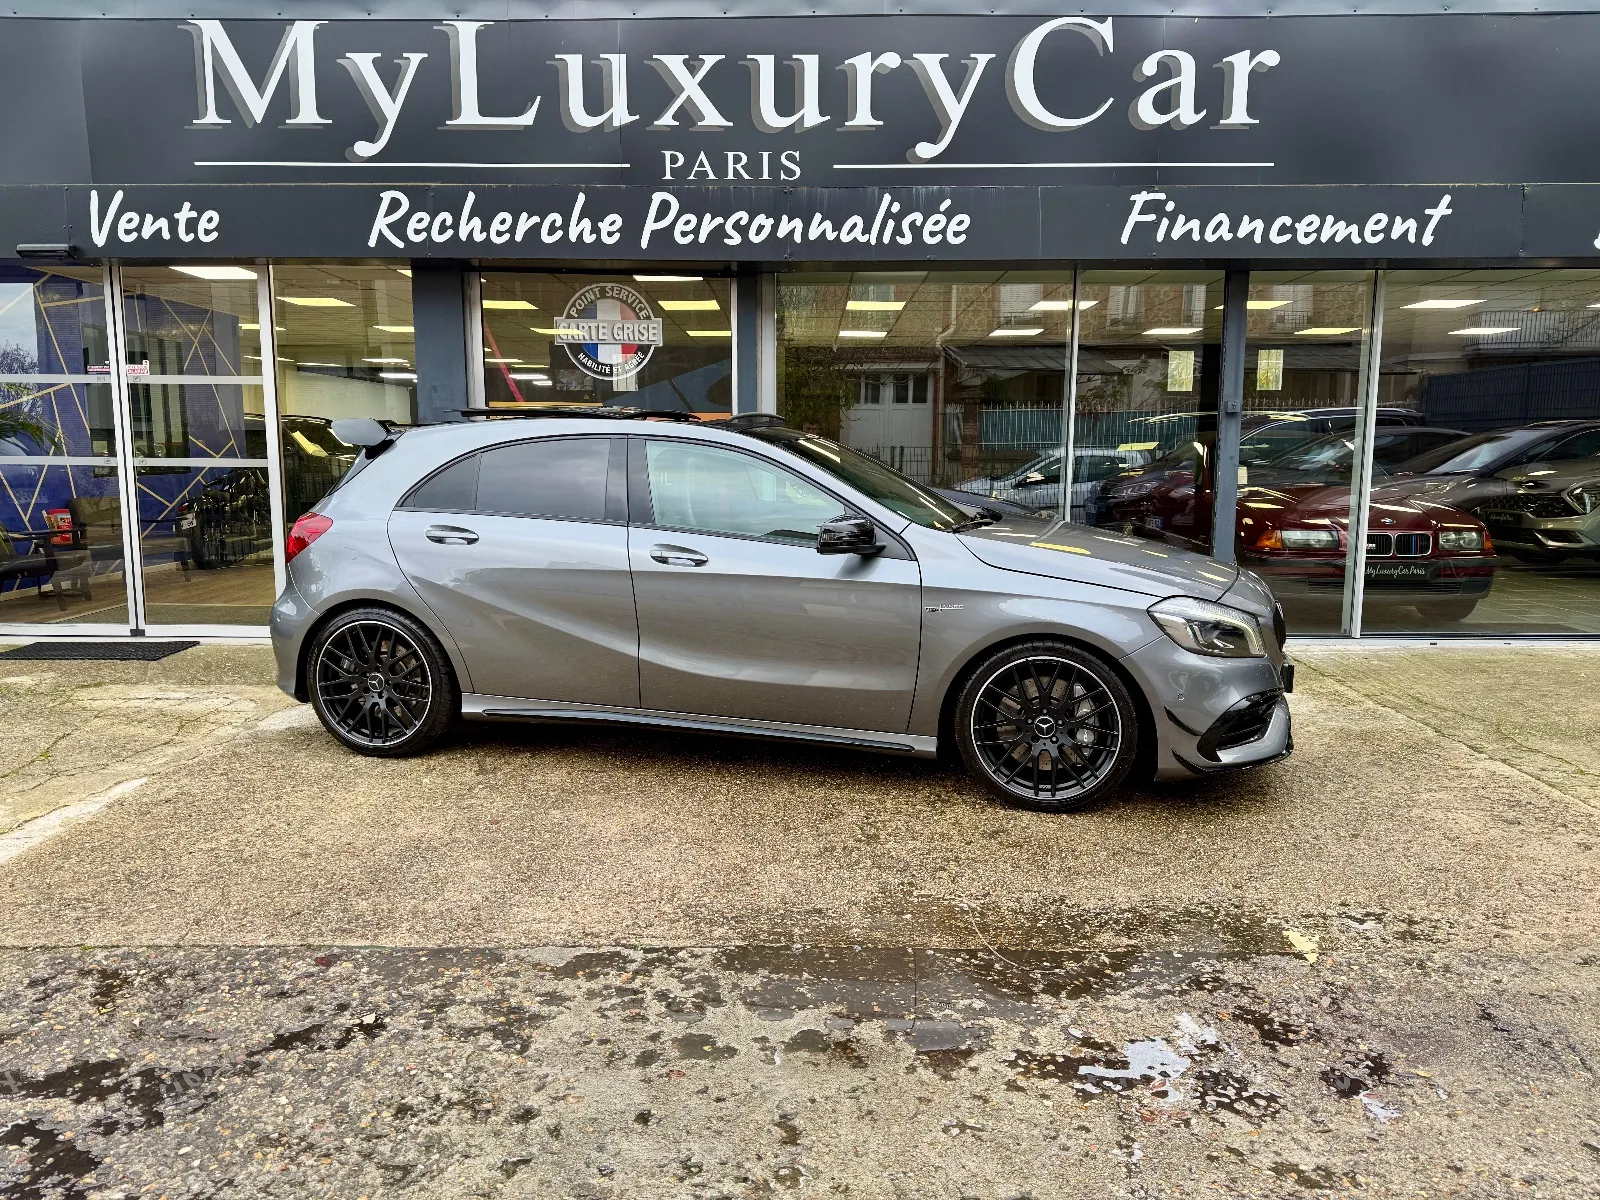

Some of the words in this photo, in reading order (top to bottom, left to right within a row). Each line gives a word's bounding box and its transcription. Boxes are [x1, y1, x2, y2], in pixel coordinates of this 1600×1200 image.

[187, 16, 1281, 160] MyLuxuryCar
[661, 150, 802, 181] PARIS
[89, 189, 220, 248] Vente
[367, 190, 623, 249] Recherche
[640, 191, 971, 250] Personnalisée
[1120, 190, 1453, 247] Financement
[569, 287, 601, 318] POINT
[605, 286, 650, 320] SERVICE
[558, 322, 608, 341] CARTE
[613, 322, 658, 341] GRISE
[613, 366, 623, 374] ET
